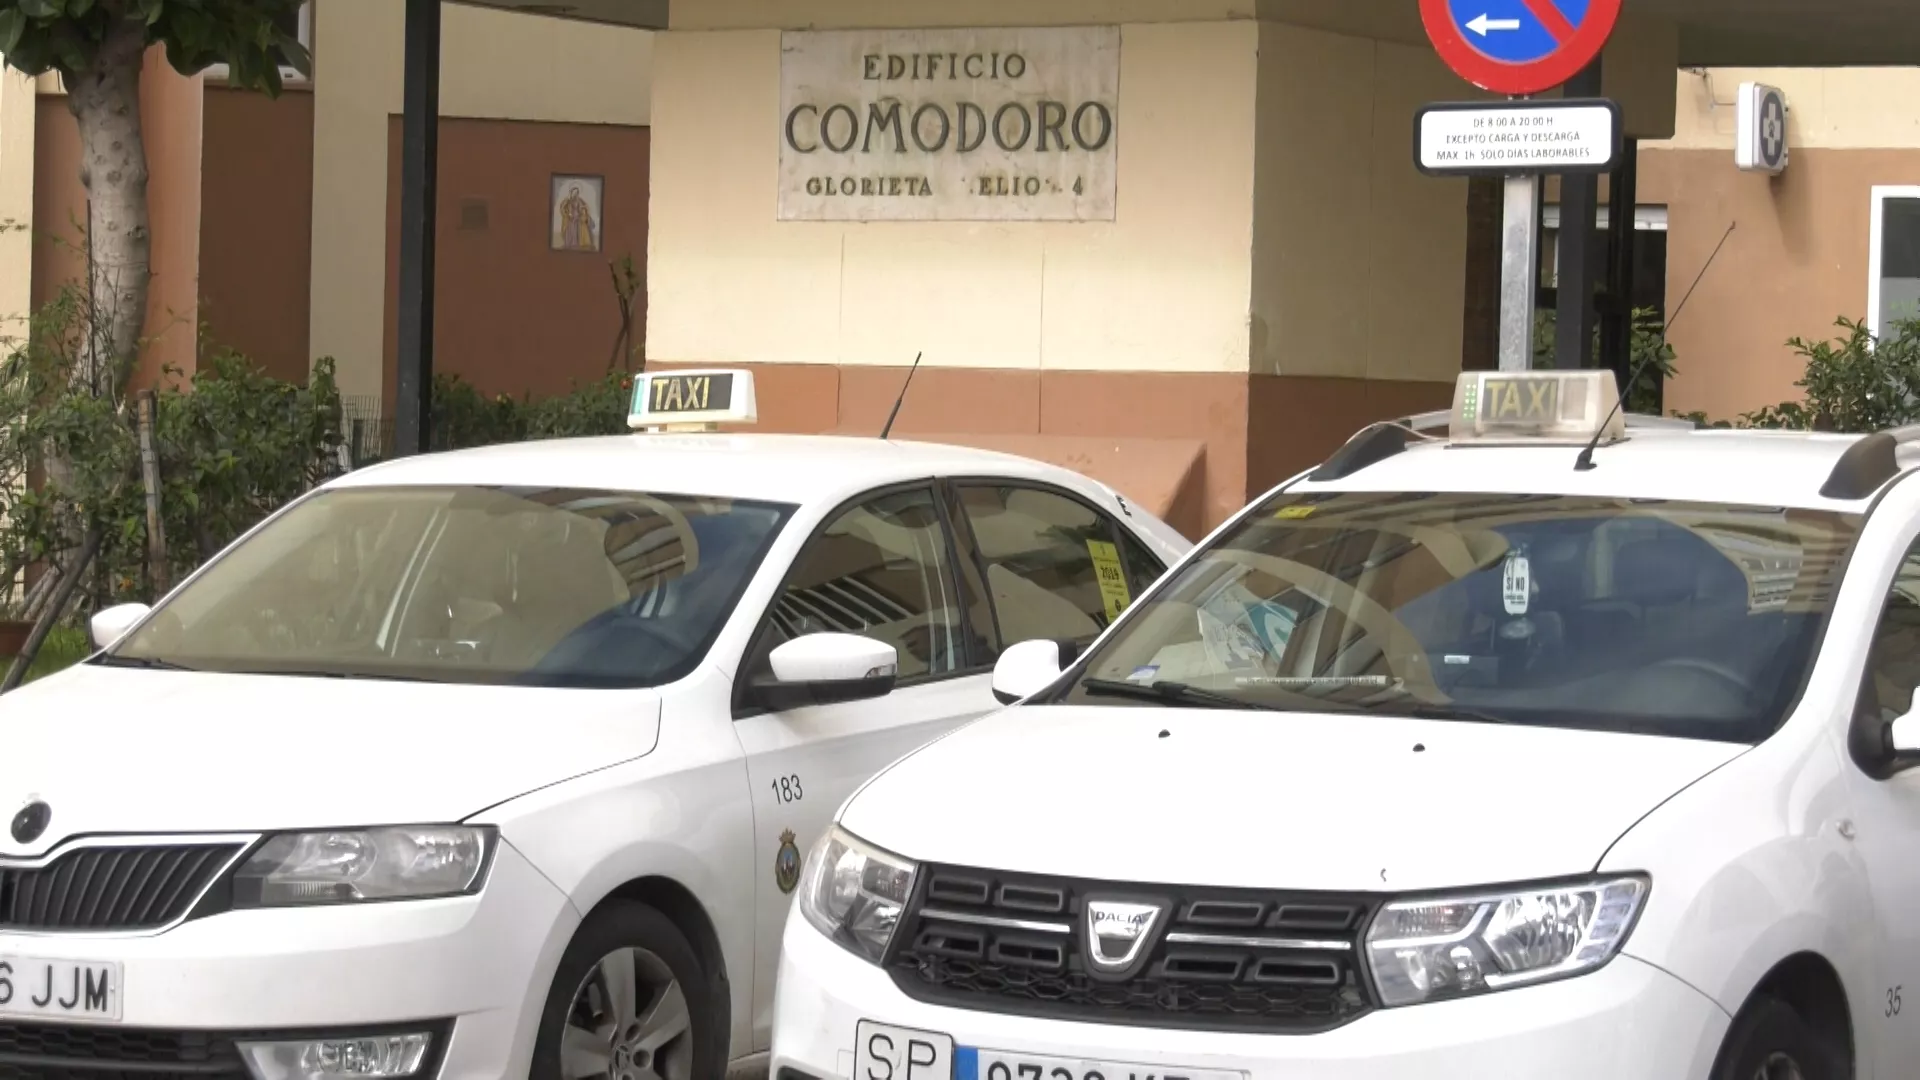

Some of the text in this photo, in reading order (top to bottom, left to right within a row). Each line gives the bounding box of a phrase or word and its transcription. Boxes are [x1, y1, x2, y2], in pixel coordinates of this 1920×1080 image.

[863, 53, 1027, 80] EDIFICIO
[784, 101, 1112, 154] COMODORO
[1473, 117, 1485, 128] DE
[1509, 116, 1516, 127] A
[1446, 131, 1580, 144] EXCEPTO CARGA Y DESCARGA
[1480, 149, 1505, 160] SOLO
[1531, 147, 1590, 158] LABORABLES
[806, 176, 1084, 197] GLORIETA ELIO 4
[652, 376, 710, 411] TAXI
[1486, 381, 1558, 418] TAXI
[772, 773, 803, 805] 183
[1095, 910, 1143, 925] DACIA
[31, 963, 109, 1013] JJM
[1884, 985, 1903, 1019] 35
